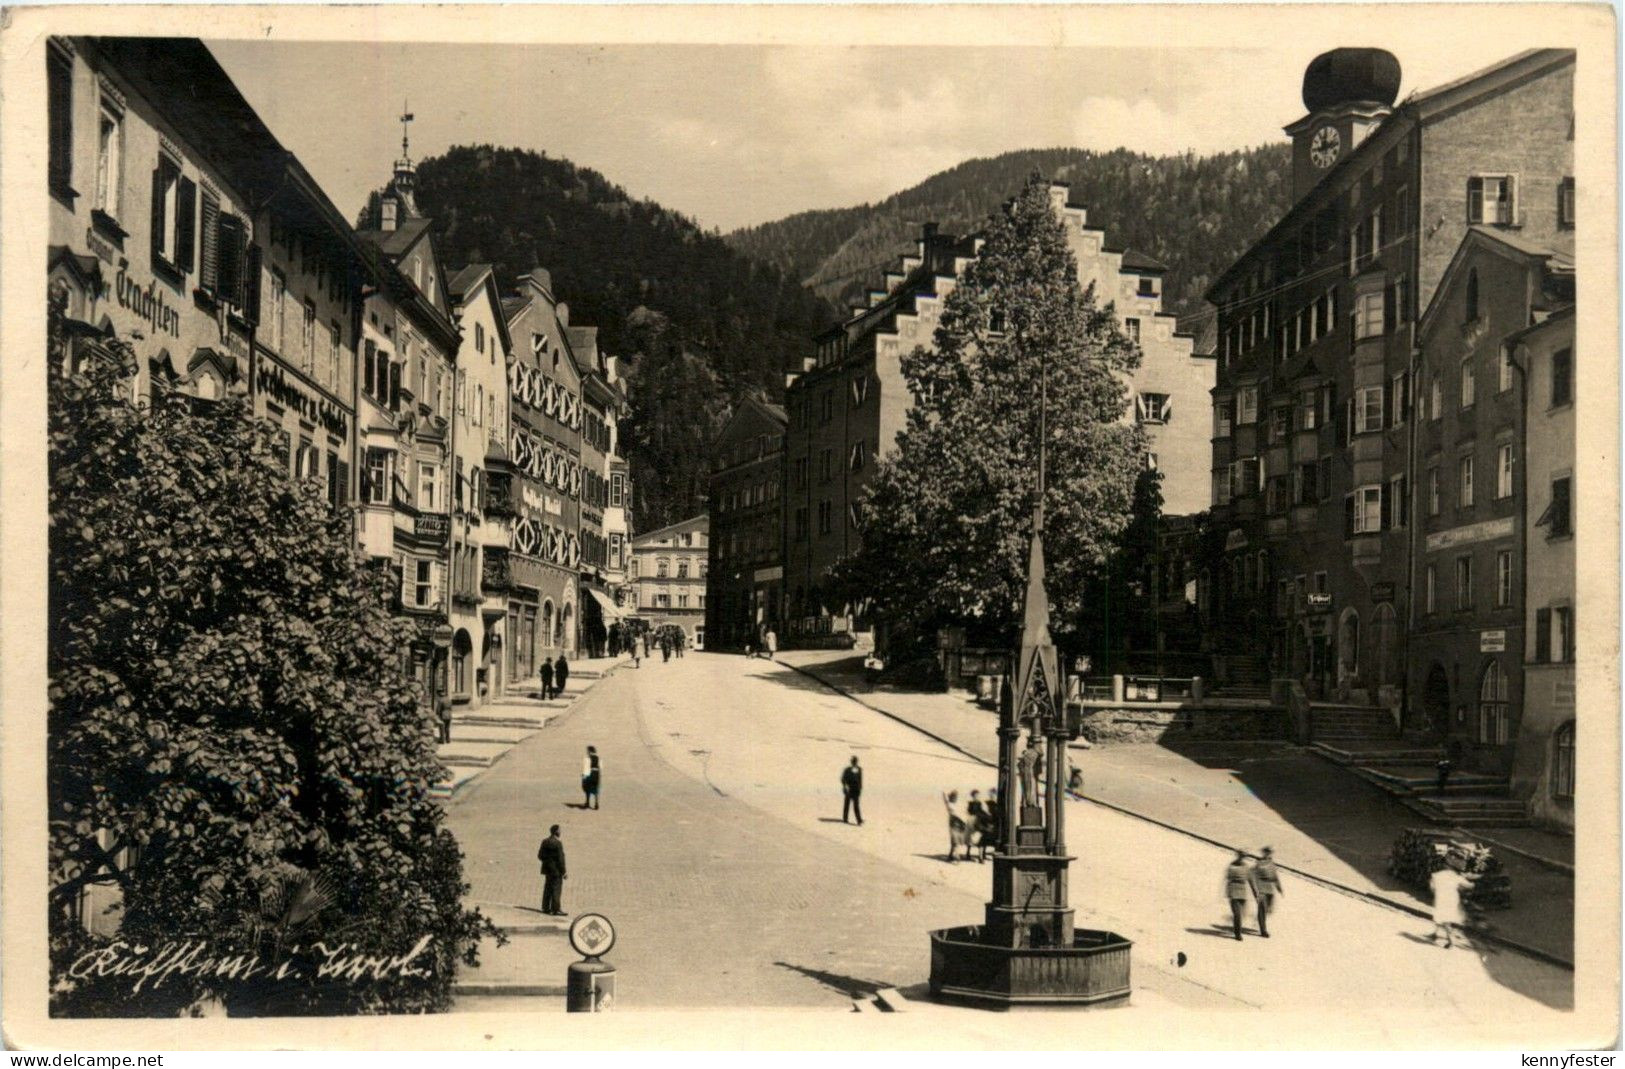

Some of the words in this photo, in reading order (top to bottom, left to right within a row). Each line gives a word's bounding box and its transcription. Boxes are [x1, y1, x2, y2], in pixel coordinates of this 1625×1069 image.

[115, 258, 179, 339] Trachten
[69, 941, 264, 994] Kufstein
[311, 934, 433, 982] Tirol.
